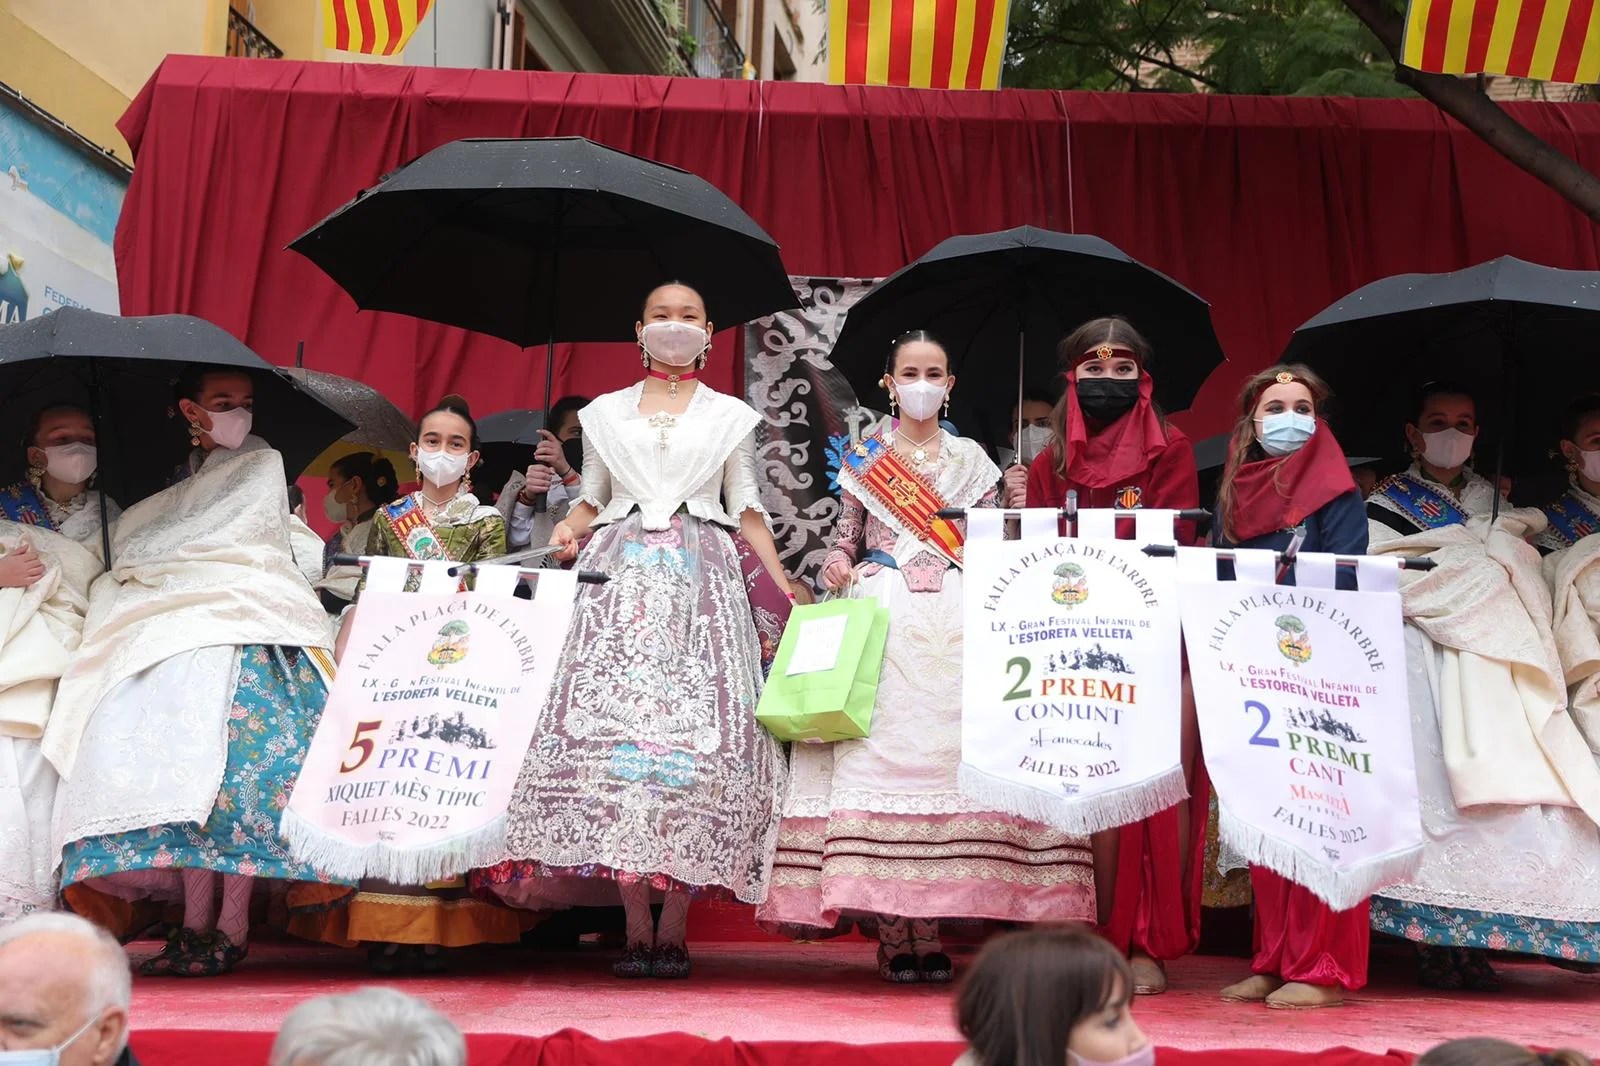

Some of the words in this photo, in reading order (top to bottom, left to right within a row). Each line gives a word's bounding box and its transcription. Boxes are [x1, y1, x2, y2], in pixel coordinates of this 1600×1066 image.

[984, 567, 1021, 611] FALLA
[1020, 543, 1076, 567] PLAÇA
[1083, 546, 1108, 562] DE
[1108, 555, 1159, 609] L'ARBRE
[358, 625, 406, 671] FALLA
[410, 600, 468, 626] PLAÇA
[474, 602, 500, 622] DE
[499, 618, 536, 676] L'ARBRE
[991, 621, 1007, 632] LX
[1139, 620, 1152, 628] DE
[1009, 628, 1077, 644] L'ESTORETA
[1082, 628, 1133, 640] VELLETA
[1209, 609, 1242, 651] FALLA
[1240, 592, 1296, 611] PLAÇA
[1302, 596, 1326, 614] DE
[1329, 608, 1385, 673] L'ARBRE
[362, 678, 379, 688] LX
[390, 678, 416, 687] GN
[1002, 656, 1032, 701] 2
[1040, 678, 1137, 704] PREMI
[1240, 677, 1309, 698] L'ESTORETA
[1310, 689, 1360, 708] VELLETA
[1365, 685, 1378, 695] DE
[372, 687, 440, 702] L'ESTORETA
[445, 690, 498, 709] VELLETA
[1015, 702, 1123, 725] CONJUNT
[339, 720, 382, 773] 5
[378, 748, 492, 779] PREMI
[1244, 700, 1280, 748] 2
[1286, 731, 1373, 774] PREMI
[1018, 755, 1080, 778] FALLES
[1085, 759, 1120, 777] 2022
[1289, 757, 1346, 786] CANT
[324, 780, 390, 803] XIQUET
[391, 777, 431, 801] MÈS
[435, 786, 487, 807] TÍPIC
[341, 806, 404, 826] FALLES
[407, 811, 450, 829] 2022
[1272, 806, 1337, 840] FALLES
[1339, 826, 1368, 843] 2022
